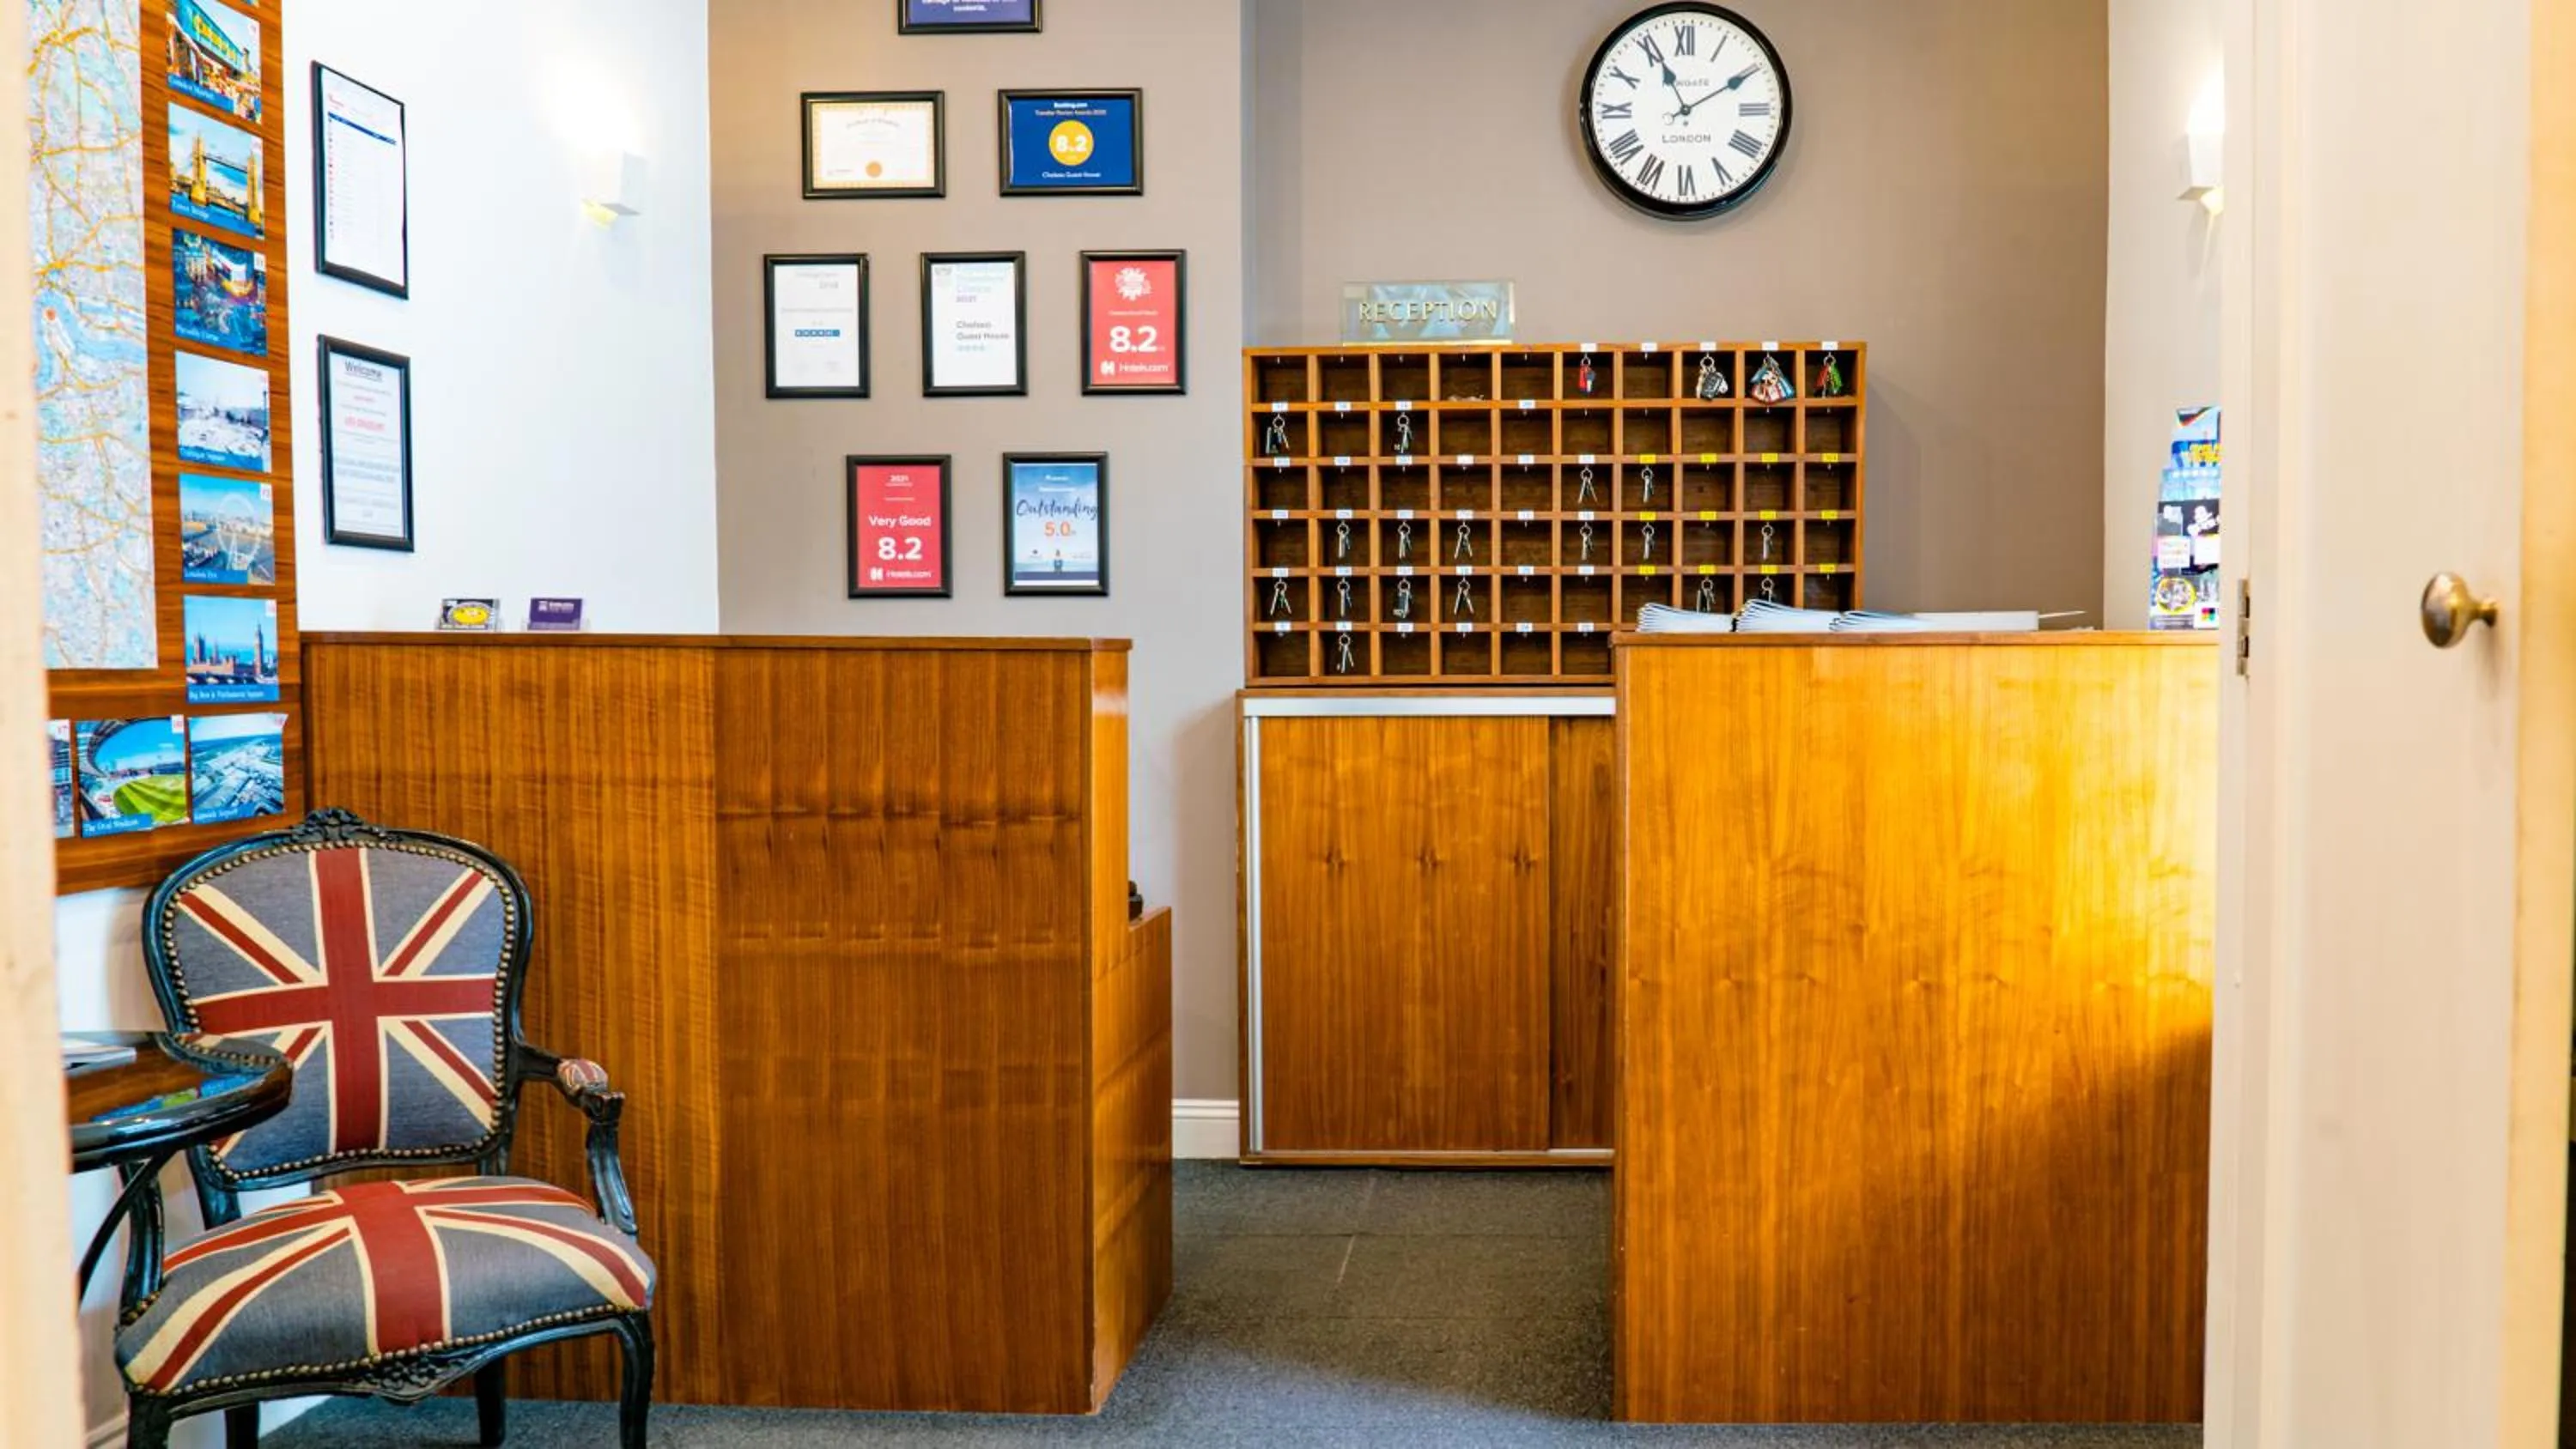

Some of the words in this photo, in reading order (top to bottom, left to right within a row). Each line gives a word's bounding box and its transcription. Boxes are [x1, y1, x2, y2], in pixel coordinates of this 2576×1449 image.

[1056, 135, 1087, 152] 8.2
[1662, 134, 1710, 144] LONDON
[1358, 301, 1497, 322] RECEPTION
[1109, 325, 1157, 353] 8.2
[345, 361, 383, 379] Welcome
[1017, 498, 1098, 520] Outstanding
[868, 515, 896, 528] Very
[899, 515, 932, 527] Good
[1044, 521, 1071, 537] 5.0
[878, 537, 922, 560] 8.2
